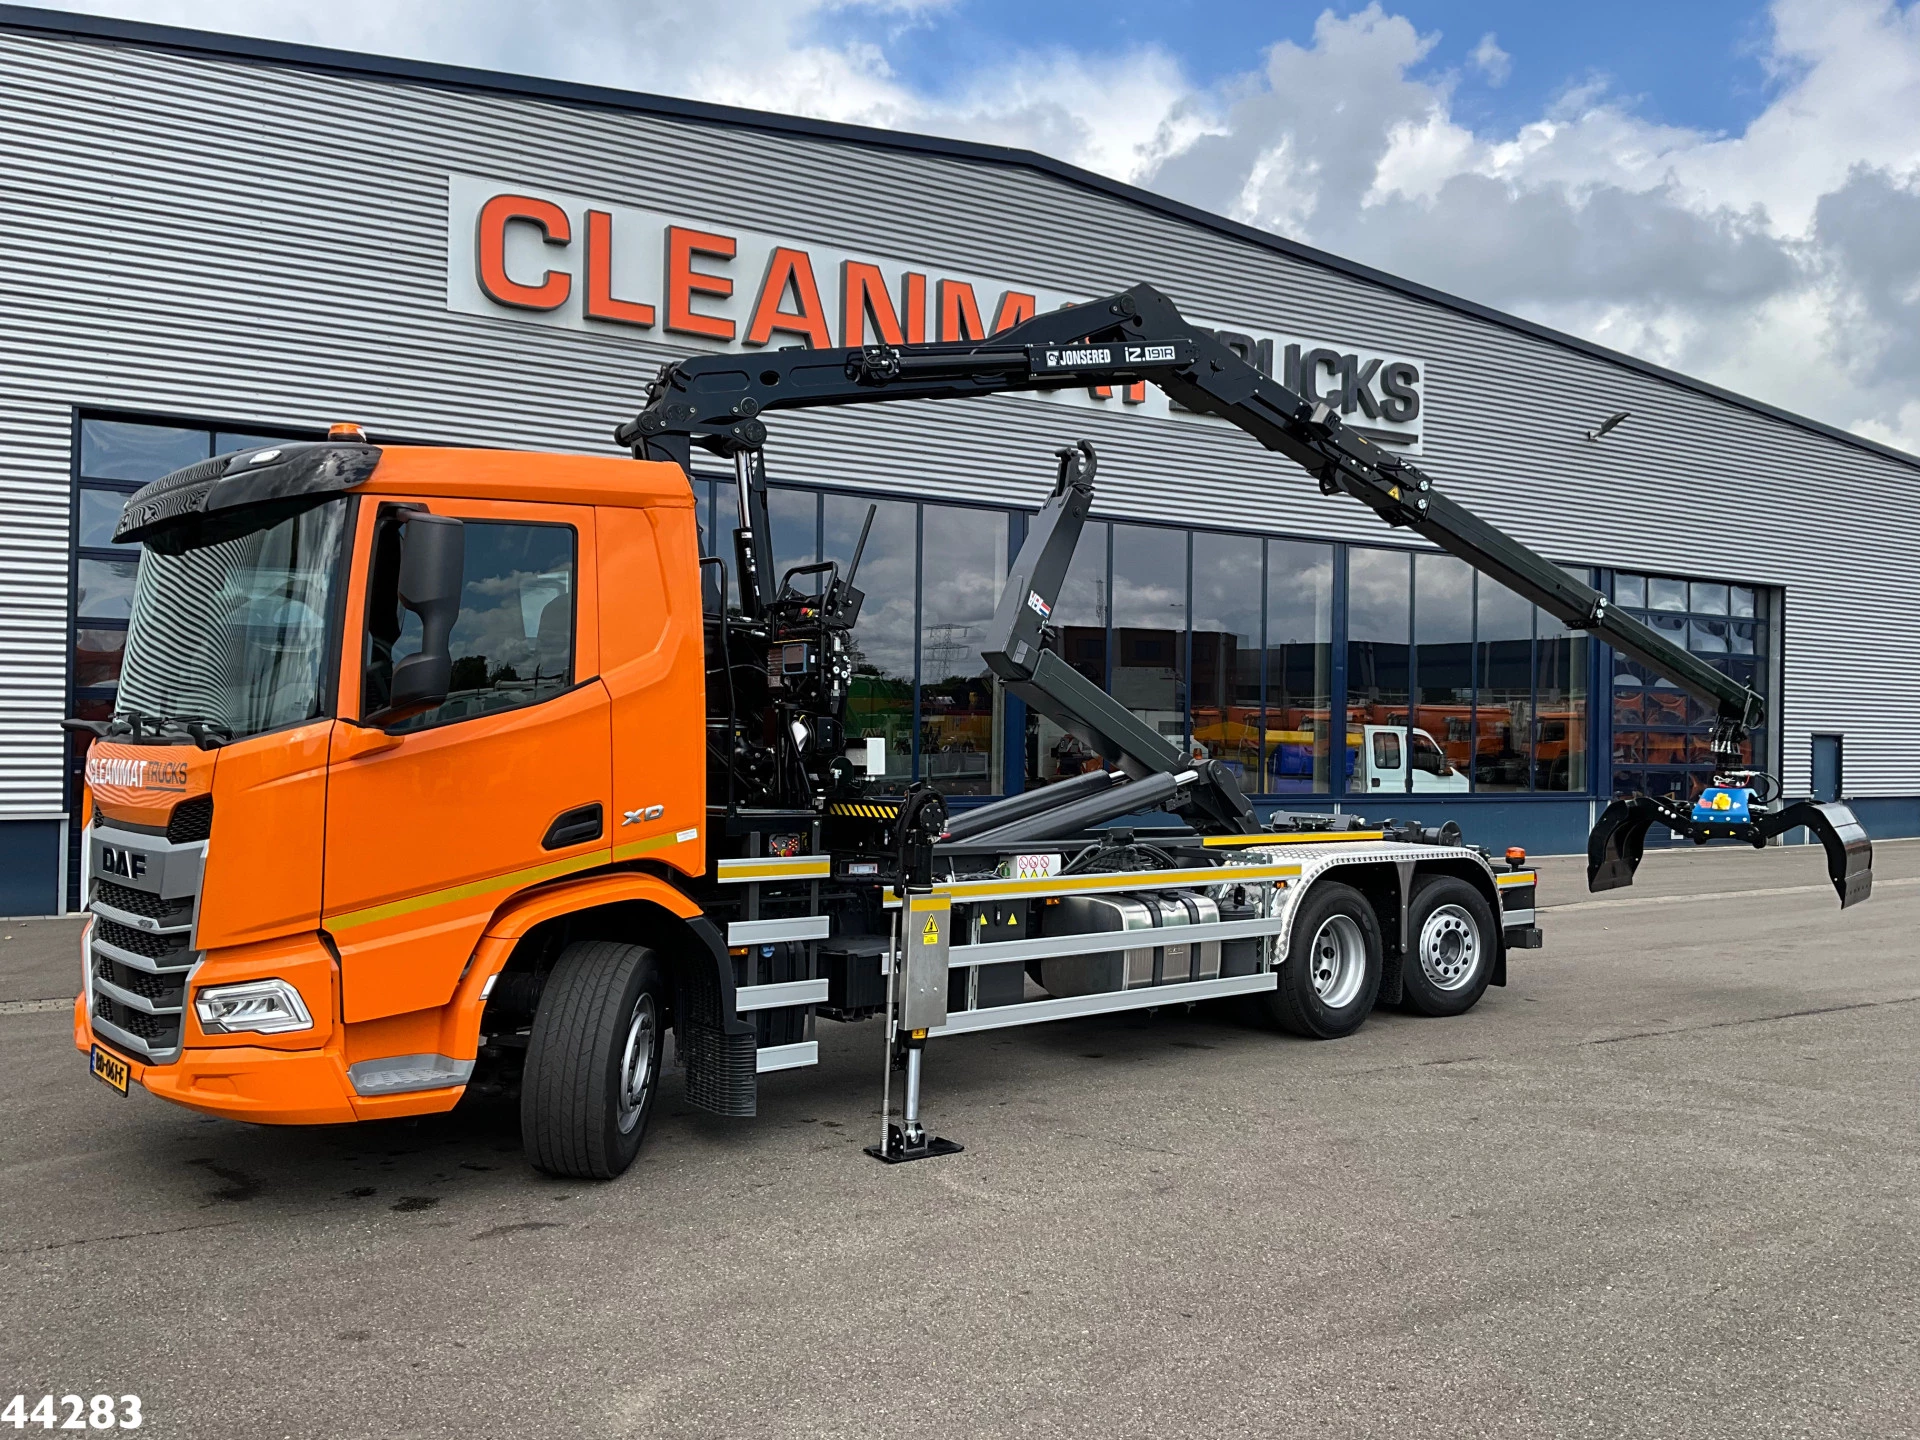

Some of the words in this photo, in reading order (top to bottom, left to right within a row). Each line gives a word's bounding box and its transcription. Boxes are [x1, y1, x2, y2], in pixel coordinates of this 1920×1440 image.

[1060, 348, 1111, 366] JONSERED
[89, 758, 148, 787] CLEANMAT
[146, 761, 188, 785] TRUCKS
[621, 804, 665, 827] XD
[102, 847, 148, 881] DAF
